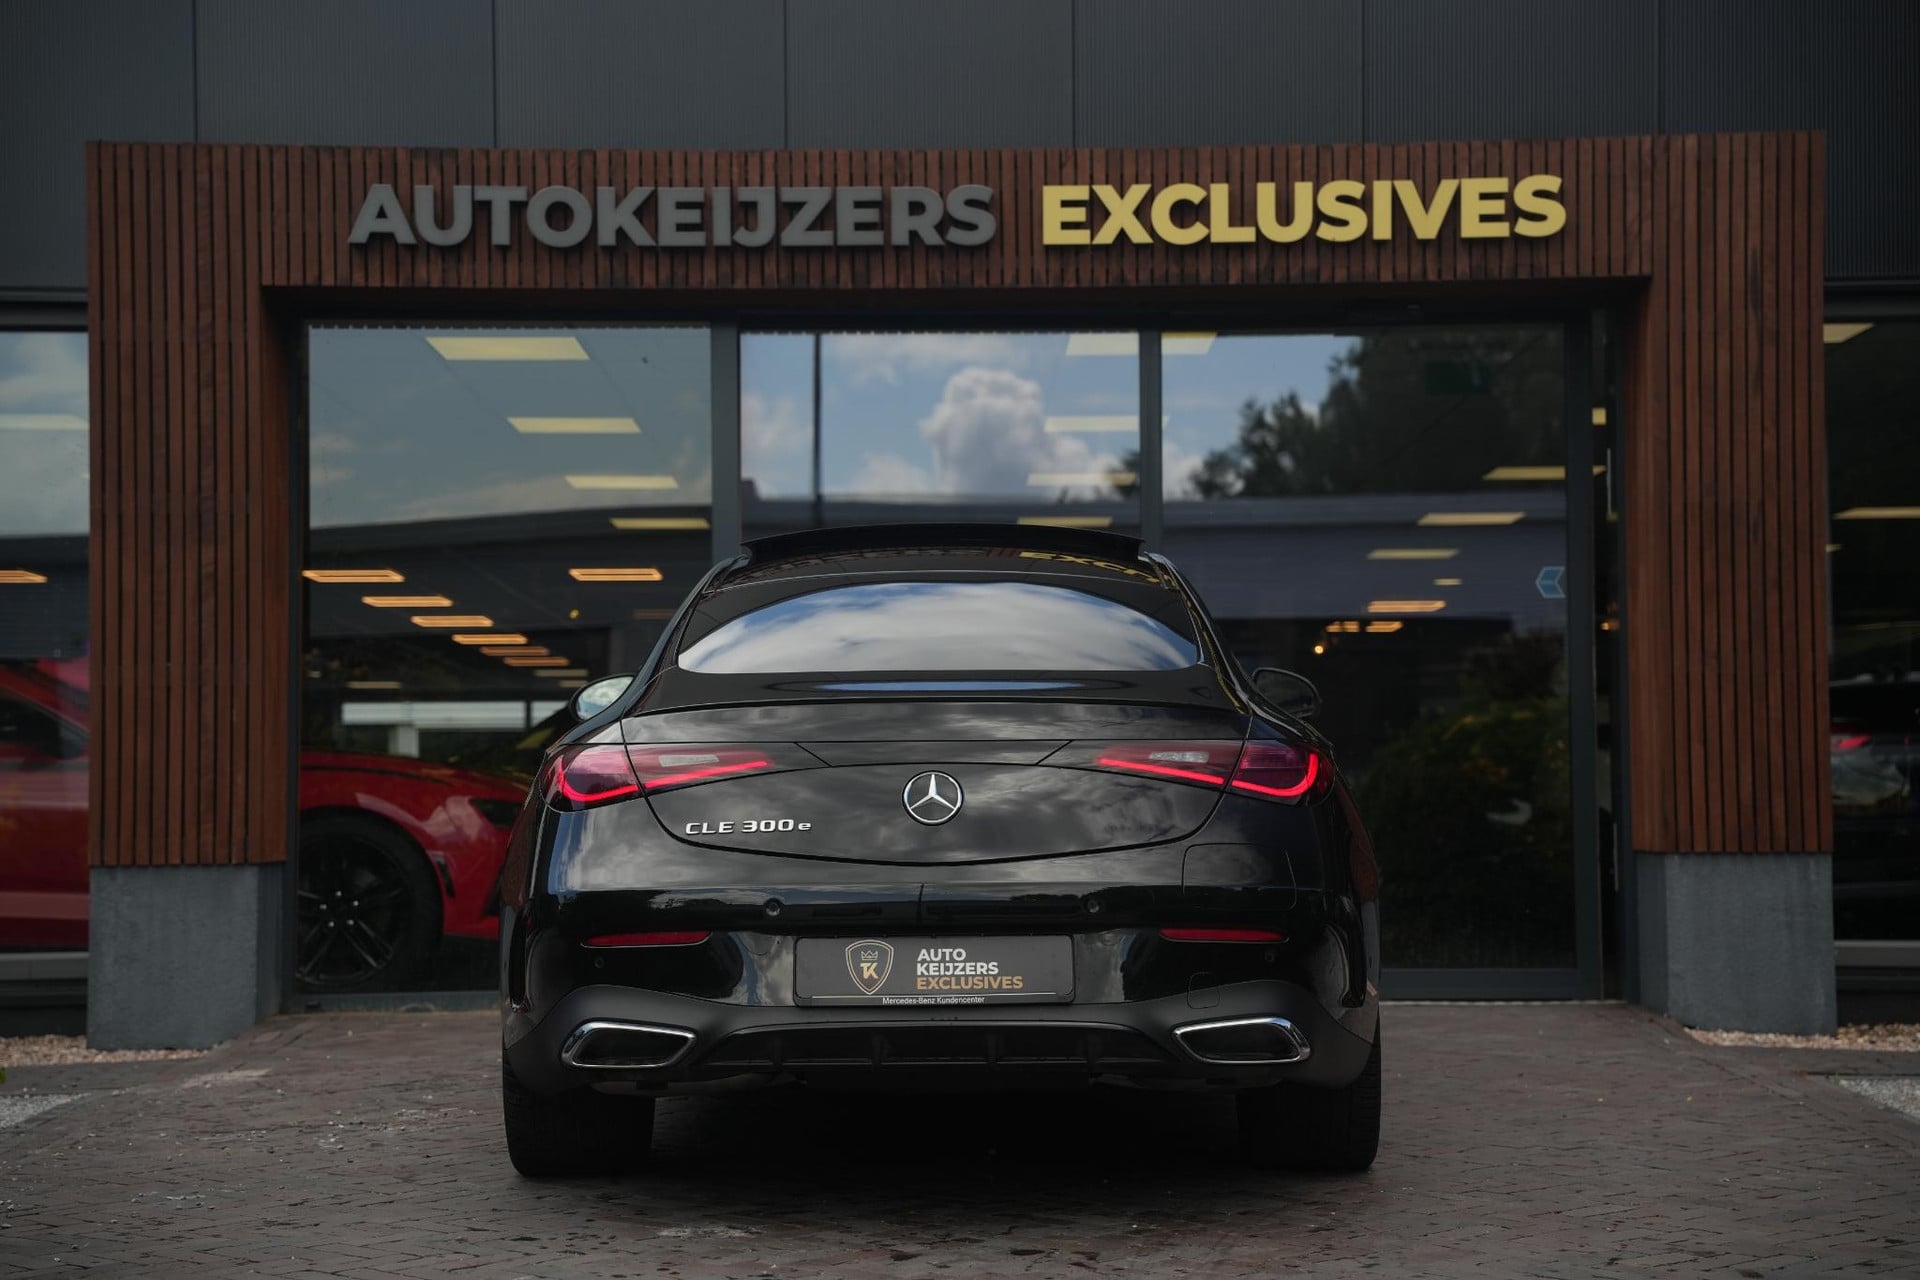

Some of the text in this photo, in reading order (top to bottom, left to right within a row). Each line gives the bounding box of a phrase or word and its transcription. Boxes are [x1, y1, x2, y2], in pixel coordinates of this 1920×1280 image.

[347, 174, 1567, 248] AUTOKEIJZERS EXCLUSIVES
[685, 821, 735, 835] CLE
[917, 948, 967, 961] AUTO
[917, 961, 999, 976] KEIJZERS
[917, 976, 1024, 990] EXCLUSIVES
[882, 995, 985, 1005] Mercedes-Benz Kundencenter
